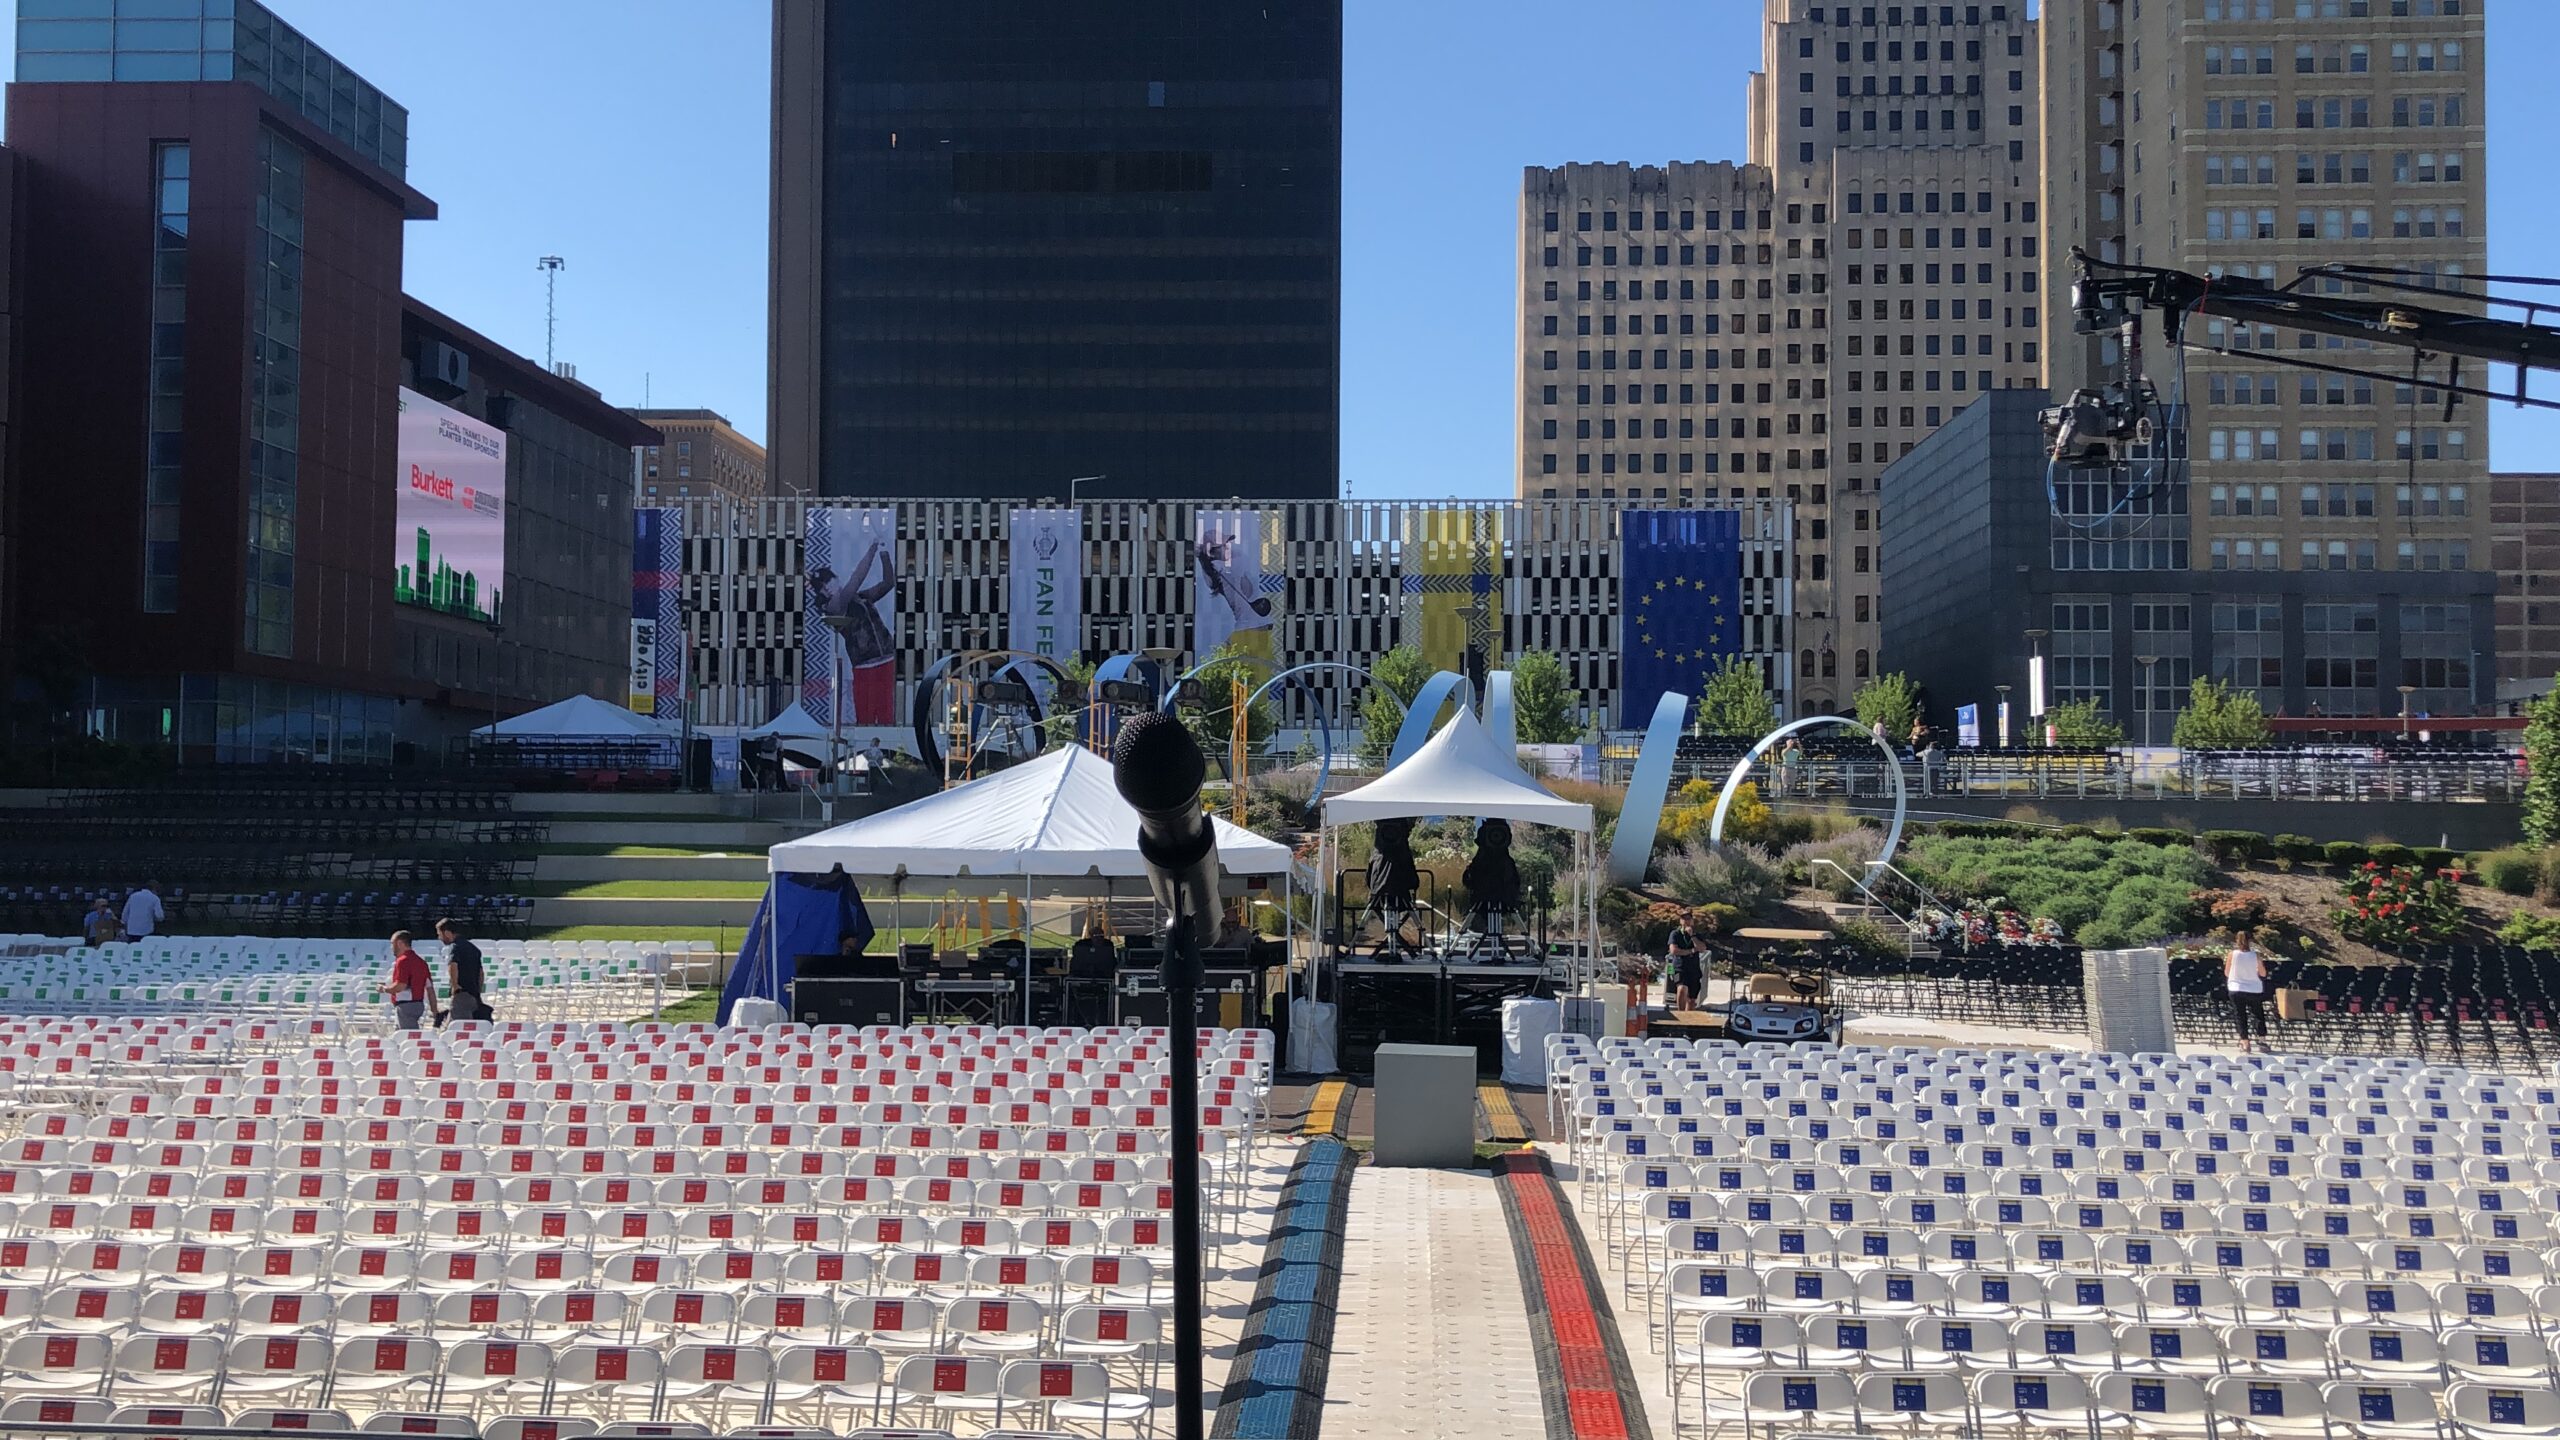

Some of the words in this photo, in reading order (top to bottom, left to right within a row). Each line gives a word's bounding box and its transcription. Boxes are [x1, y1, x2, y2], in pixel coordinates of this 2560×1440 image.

[439, 427, 462, 443] PLANTER
[463, 437, 473, 448] BOX
[474, 441, 499, 459] SPONSORS
[440, 418, 461, 434] SPECIAL
[462, 427, 481, 442] THANKS
[482, 435, 489, 445] TO
[490, 439, 500, 450] OUR
[411, 464, 454, 500] Burkett
[1036, 568, 1054, 616] FAN
[637, 625, 655, 655] egg
[634, 657, 654, 689] city
